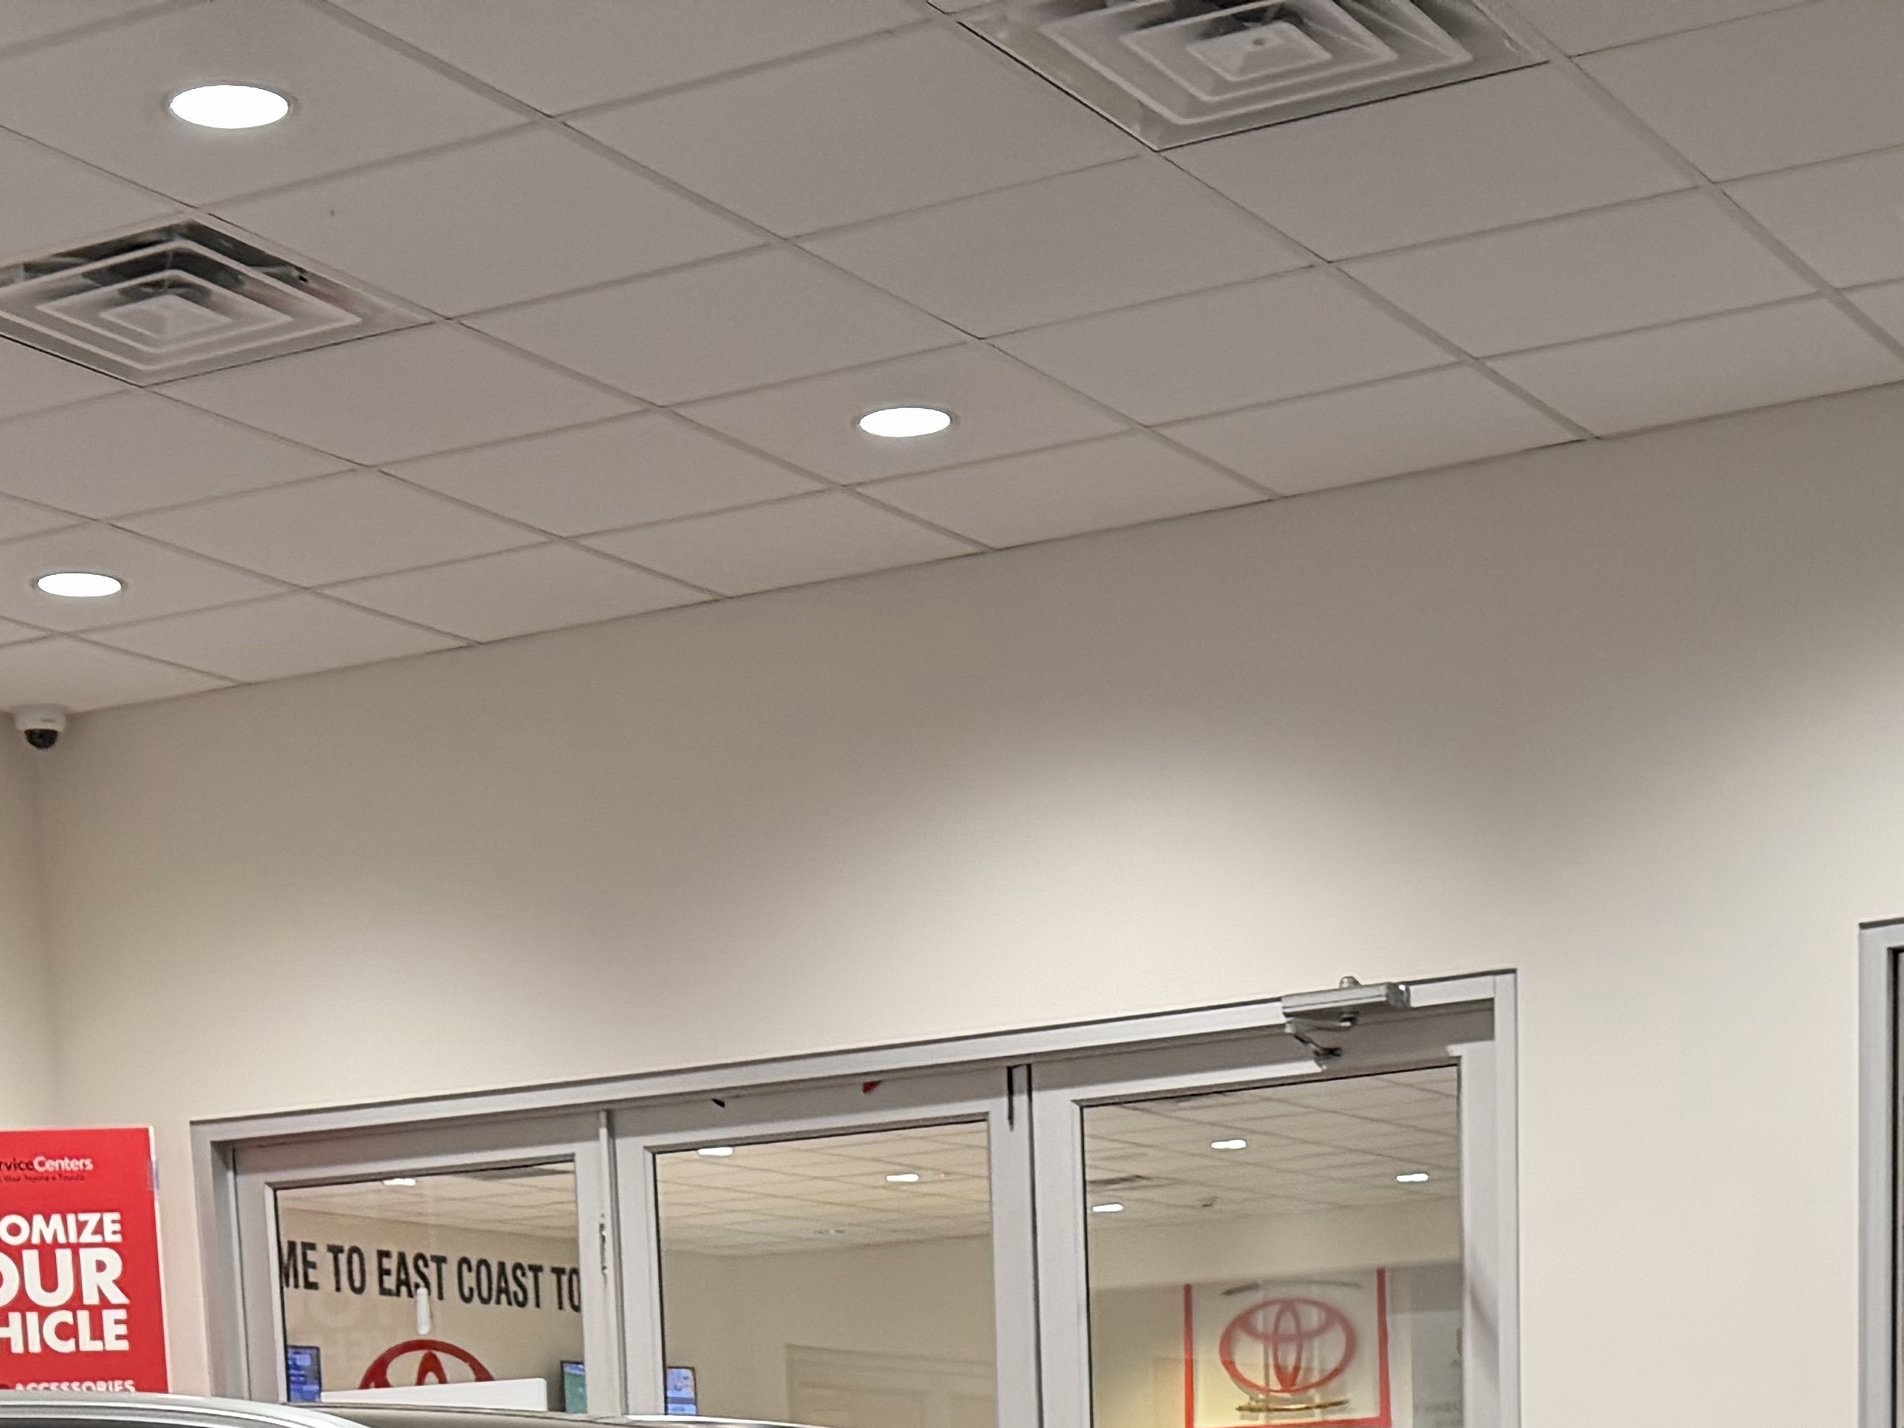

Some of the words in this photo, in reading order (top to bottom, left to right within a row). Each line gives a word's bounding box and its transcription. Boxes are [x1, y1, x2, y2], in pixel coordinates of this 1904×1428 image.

[326, 1244, 366, 1295] TO
[376, 1249, 447, 1300] EAST
[457, 1256, 543, 1308] COAST
